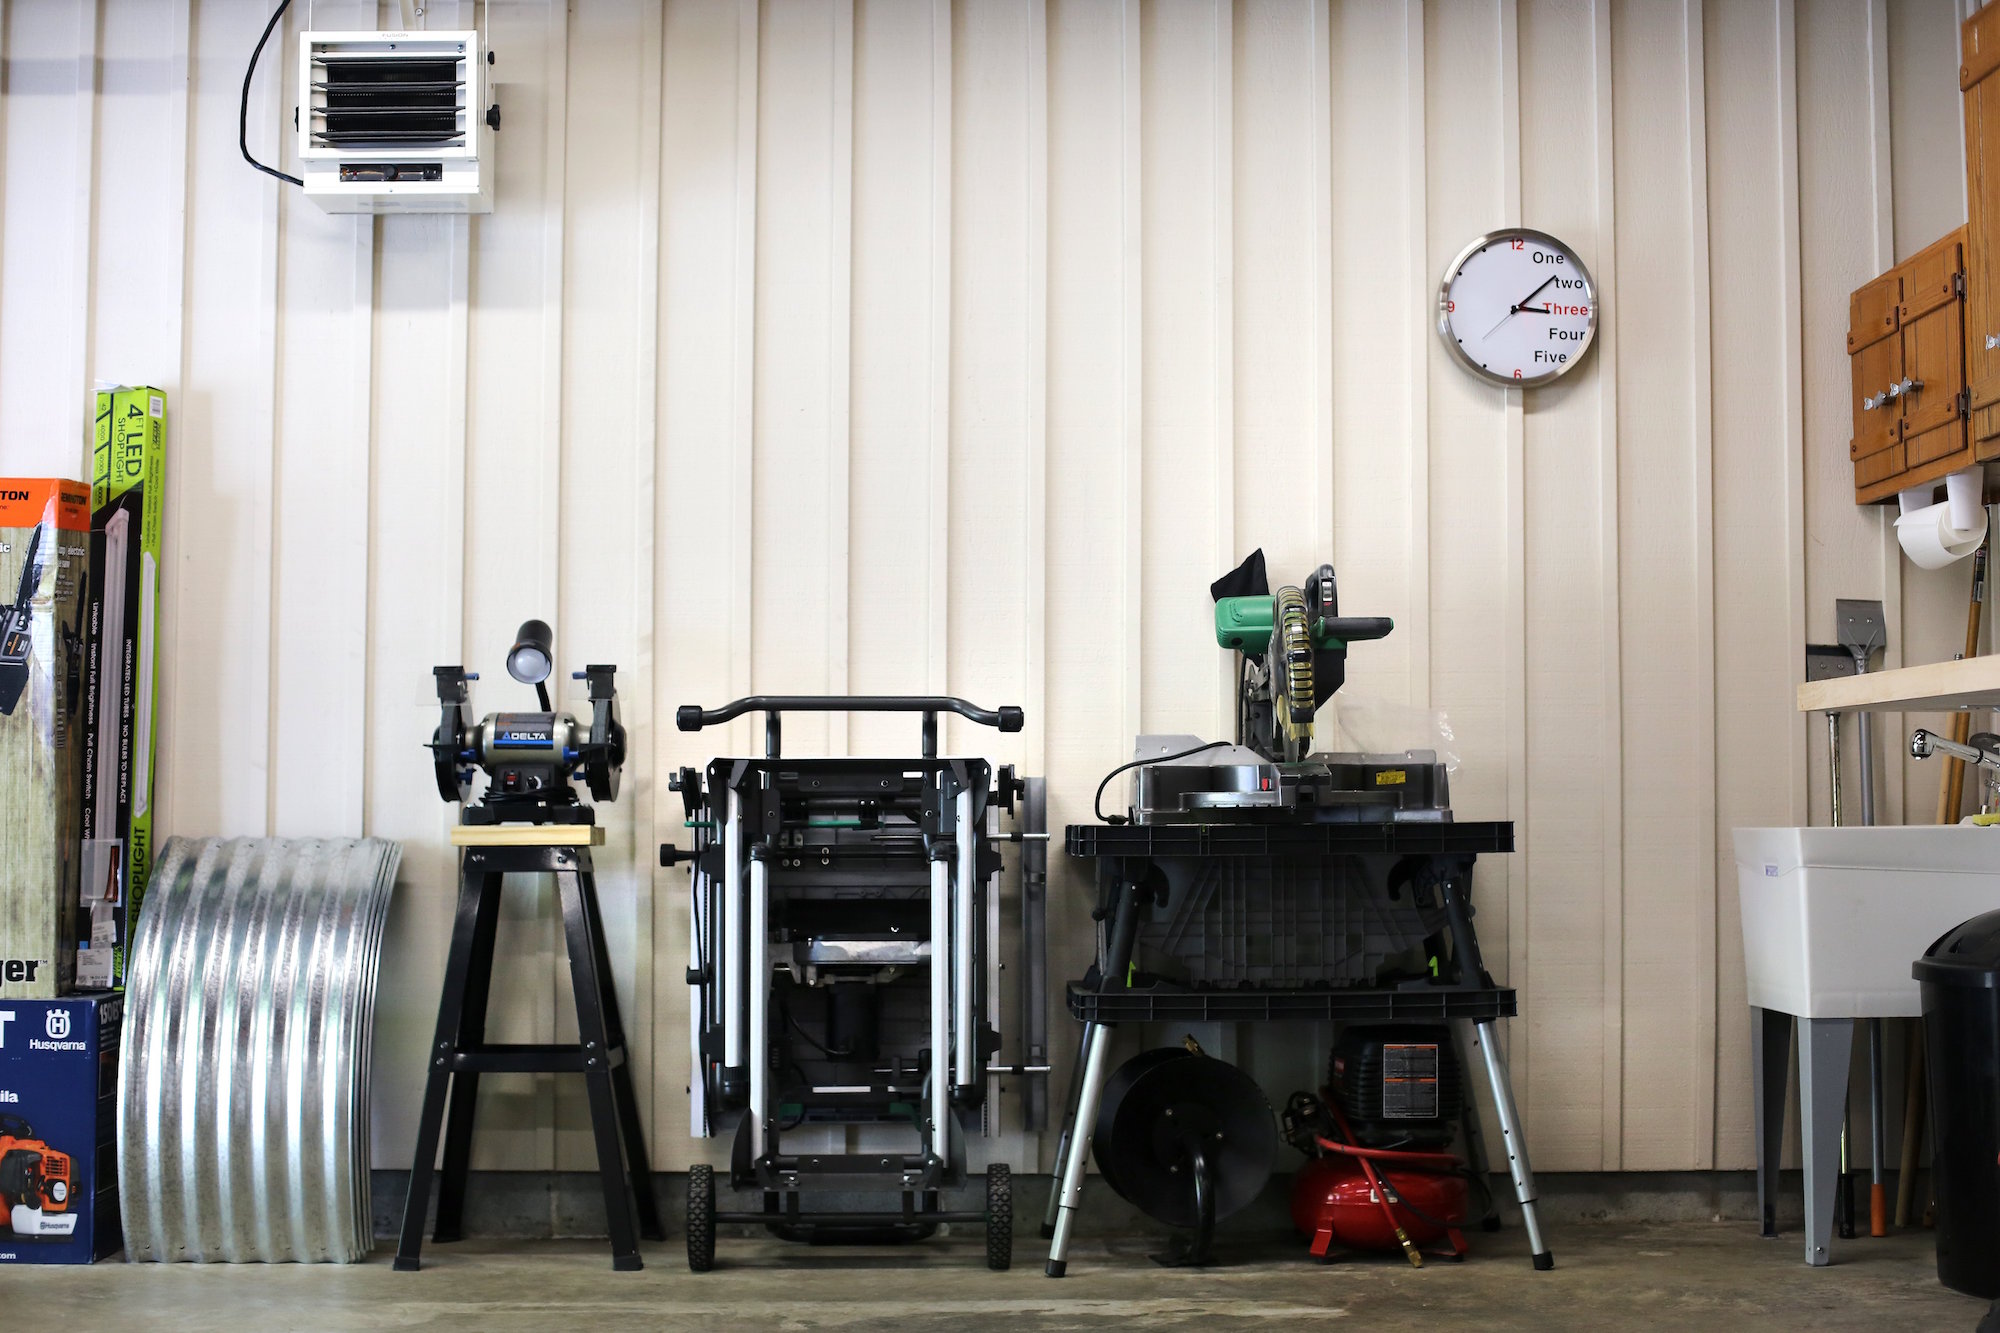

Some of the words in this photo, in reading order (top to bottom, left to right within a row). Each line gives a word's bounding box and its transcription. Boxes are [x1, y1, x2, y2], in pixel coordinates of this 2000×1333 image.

[1510, 238, 1524, 250] 12
[1533, 252, 1564, 264] One
[1555, 278, 1583, 289] two
[1448, 301, 1455, 312] 9
[1543, 303, 1588, 315] Three
[1549, 328, 1585, 340] Four
[1534, 351, 1567, 362] Five
[1514, 369, 1522, 380] 6
[116, 418, 125, 483] SHOPLIGHT
[126, 432, 142, 476] LED
[123, 725, 128, 737] NO
[121, 761, 127, 771] TO
[29, 1039, 86, 1051] Husqvarna
